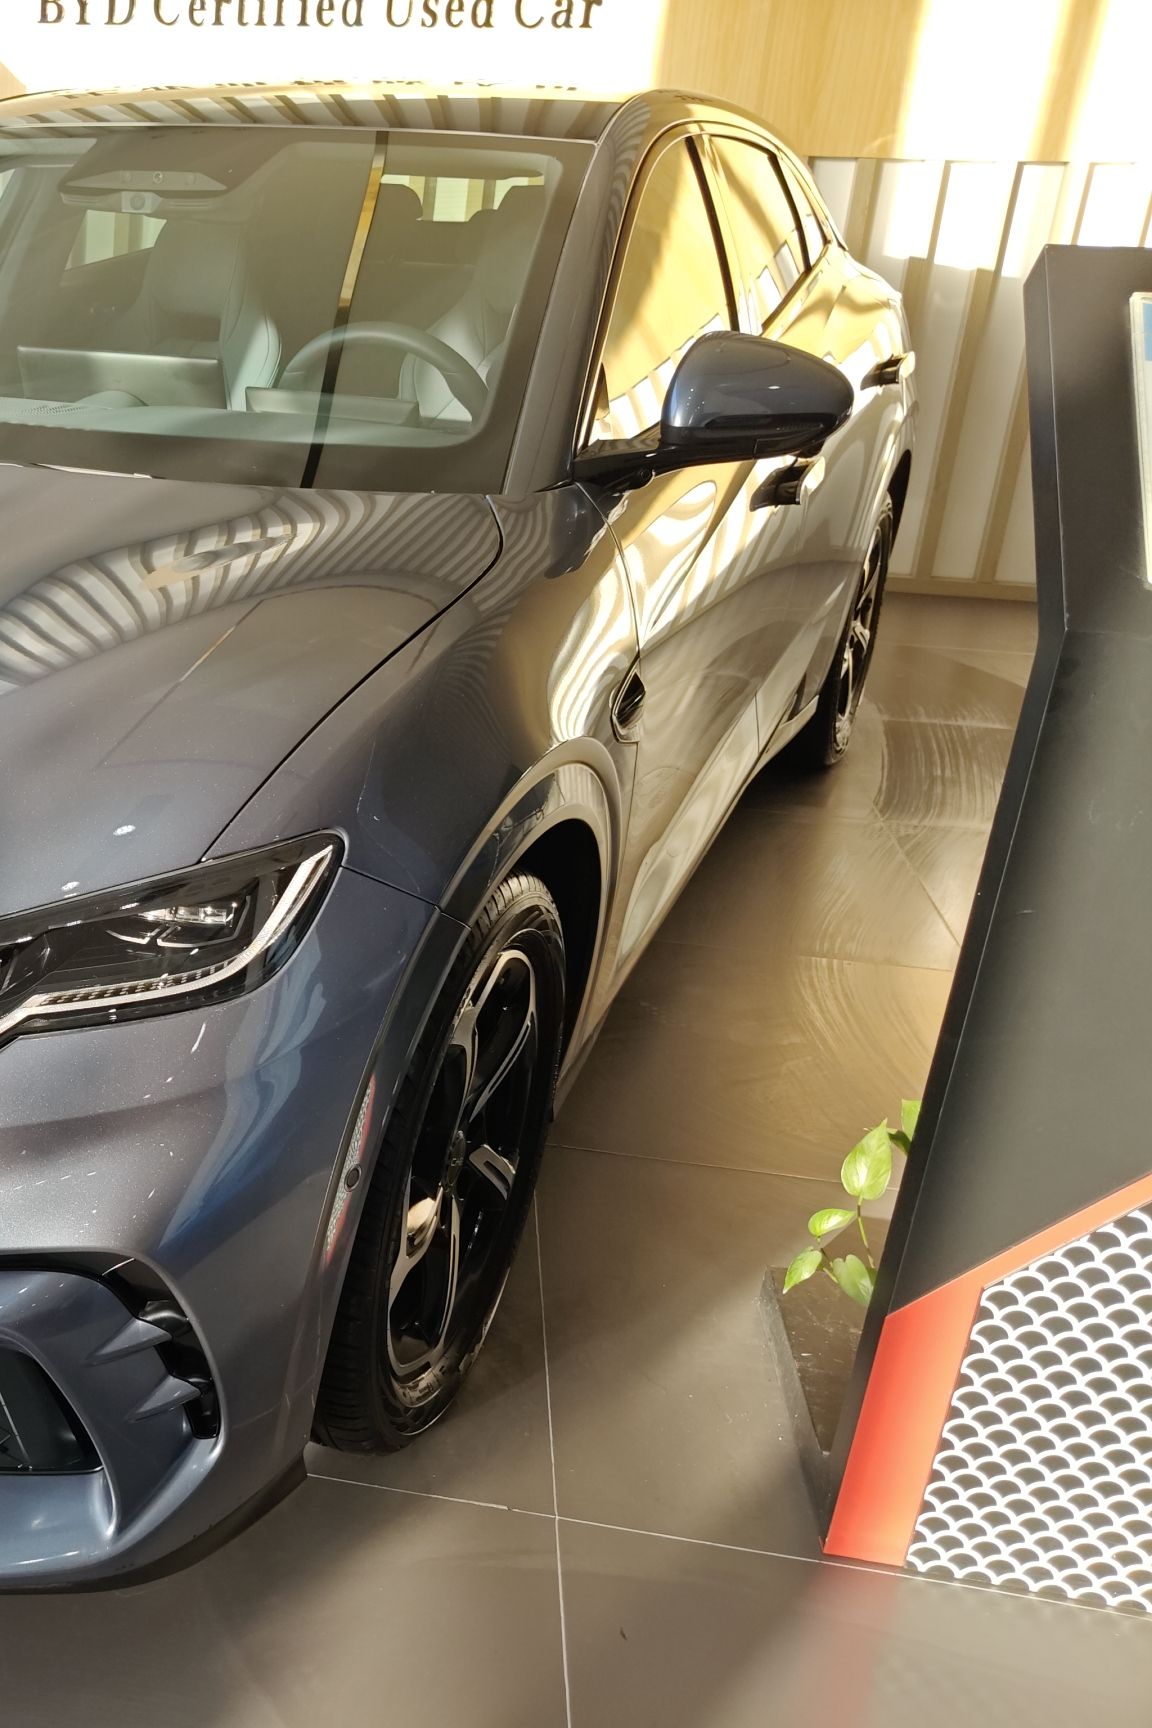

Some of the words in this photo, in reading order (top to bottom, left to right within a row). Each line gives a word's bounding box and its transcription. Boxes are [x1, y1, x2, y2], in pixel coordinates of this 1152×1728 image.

[38, 0, 136, 25] BYD
[153, 0, 365, 27] Certified
[385, 0, 495, 28] Used
[514, 0, 602, 28] Car
